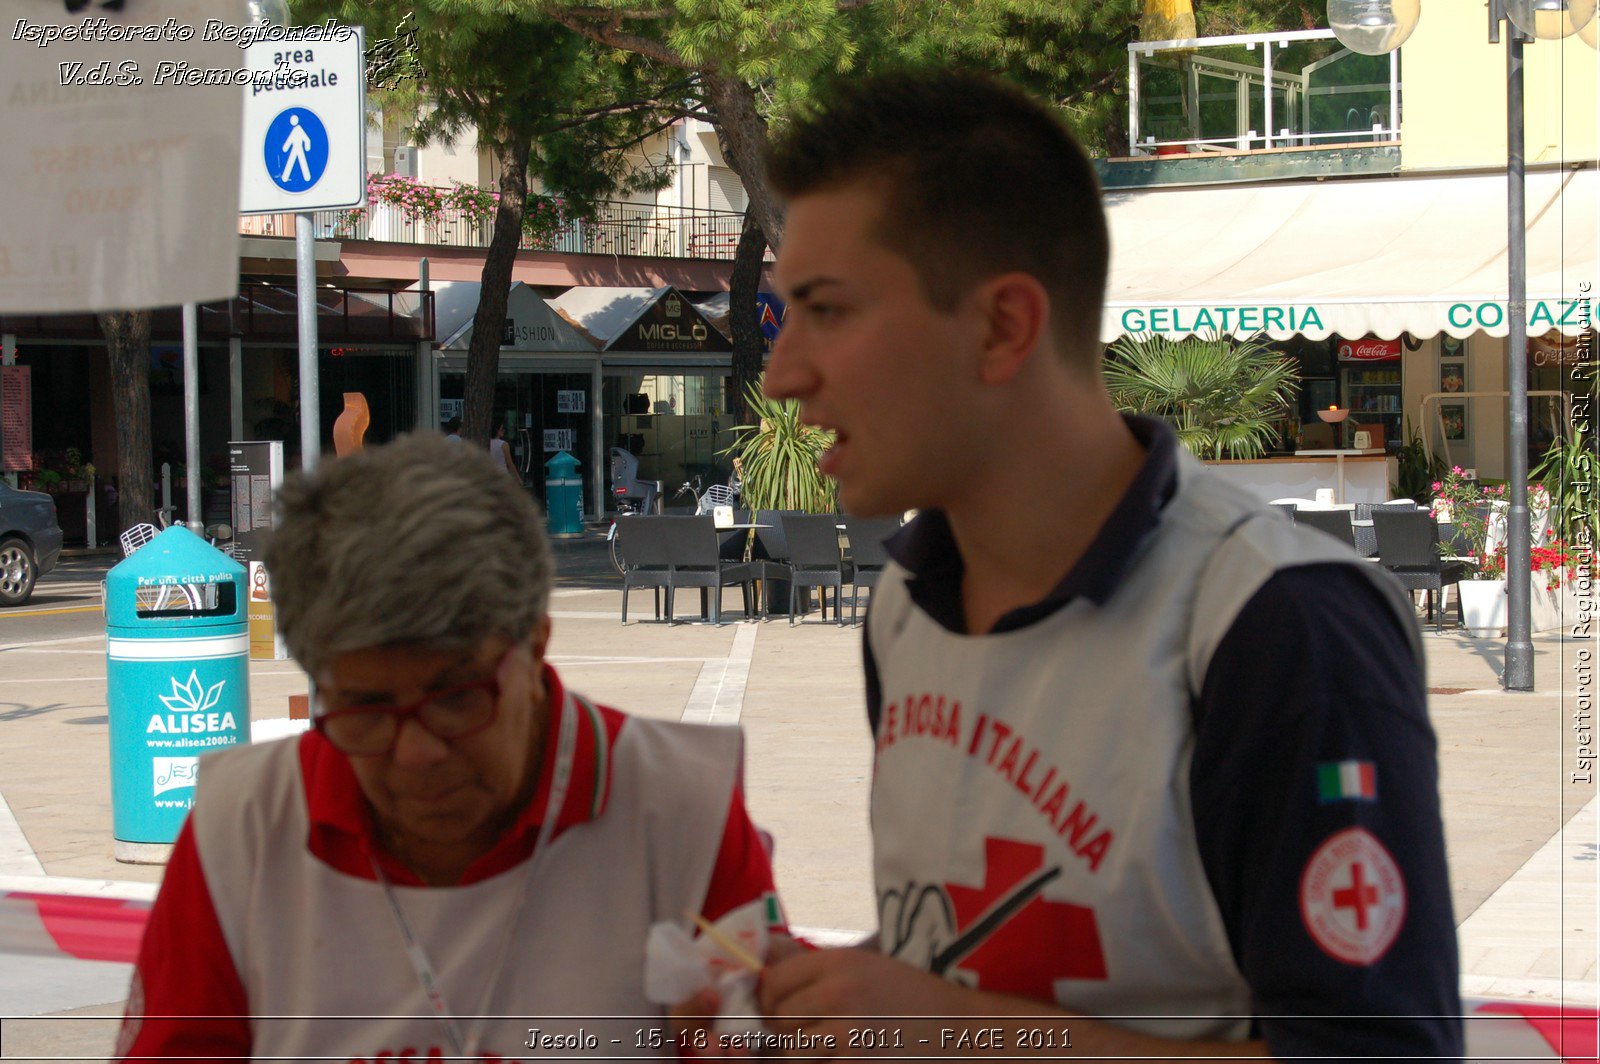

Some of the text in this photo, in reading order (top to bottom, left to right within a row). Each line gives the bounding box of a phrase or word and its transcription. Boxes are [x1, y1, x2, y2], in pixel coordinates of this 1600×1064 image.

[274, 49, 314, 65] area
[1121, 306, 1324, 332] GELATERIA
[138, 572, 233, 585] Per una città pulita
[146, 712, 237, 733] ALISEA
[146, 735, 236, 748] www.alisea2000.it
[966, 711, 1114, 874] ITALIANA
